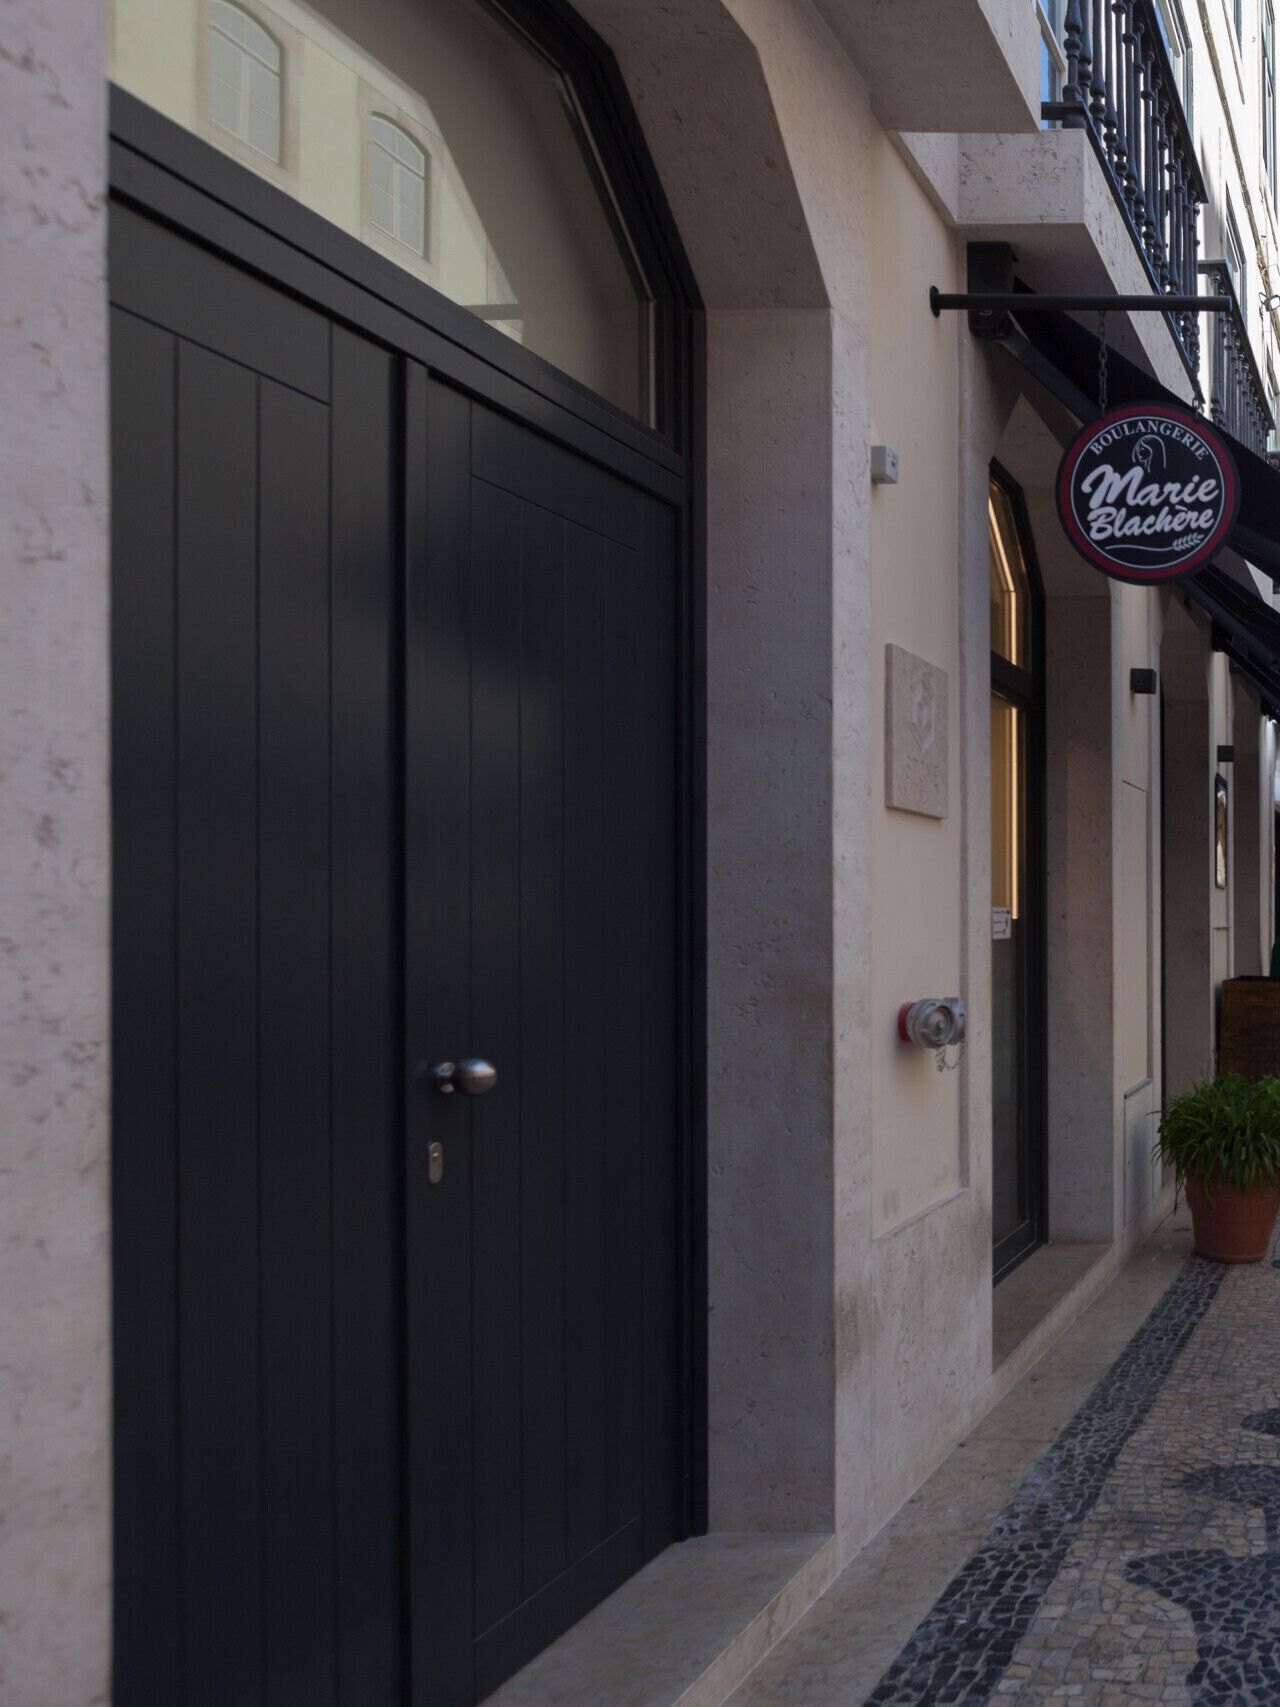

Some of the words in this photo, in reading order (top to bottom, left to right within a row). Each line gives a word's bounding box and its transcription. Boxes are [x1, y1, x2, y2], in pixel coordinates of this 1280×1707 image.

[1088, 420, 1209, 461] BOULANGERIE
[1081, 464, 1219, 510] Marie
[1087, 504, 1214, 541] Blachère
